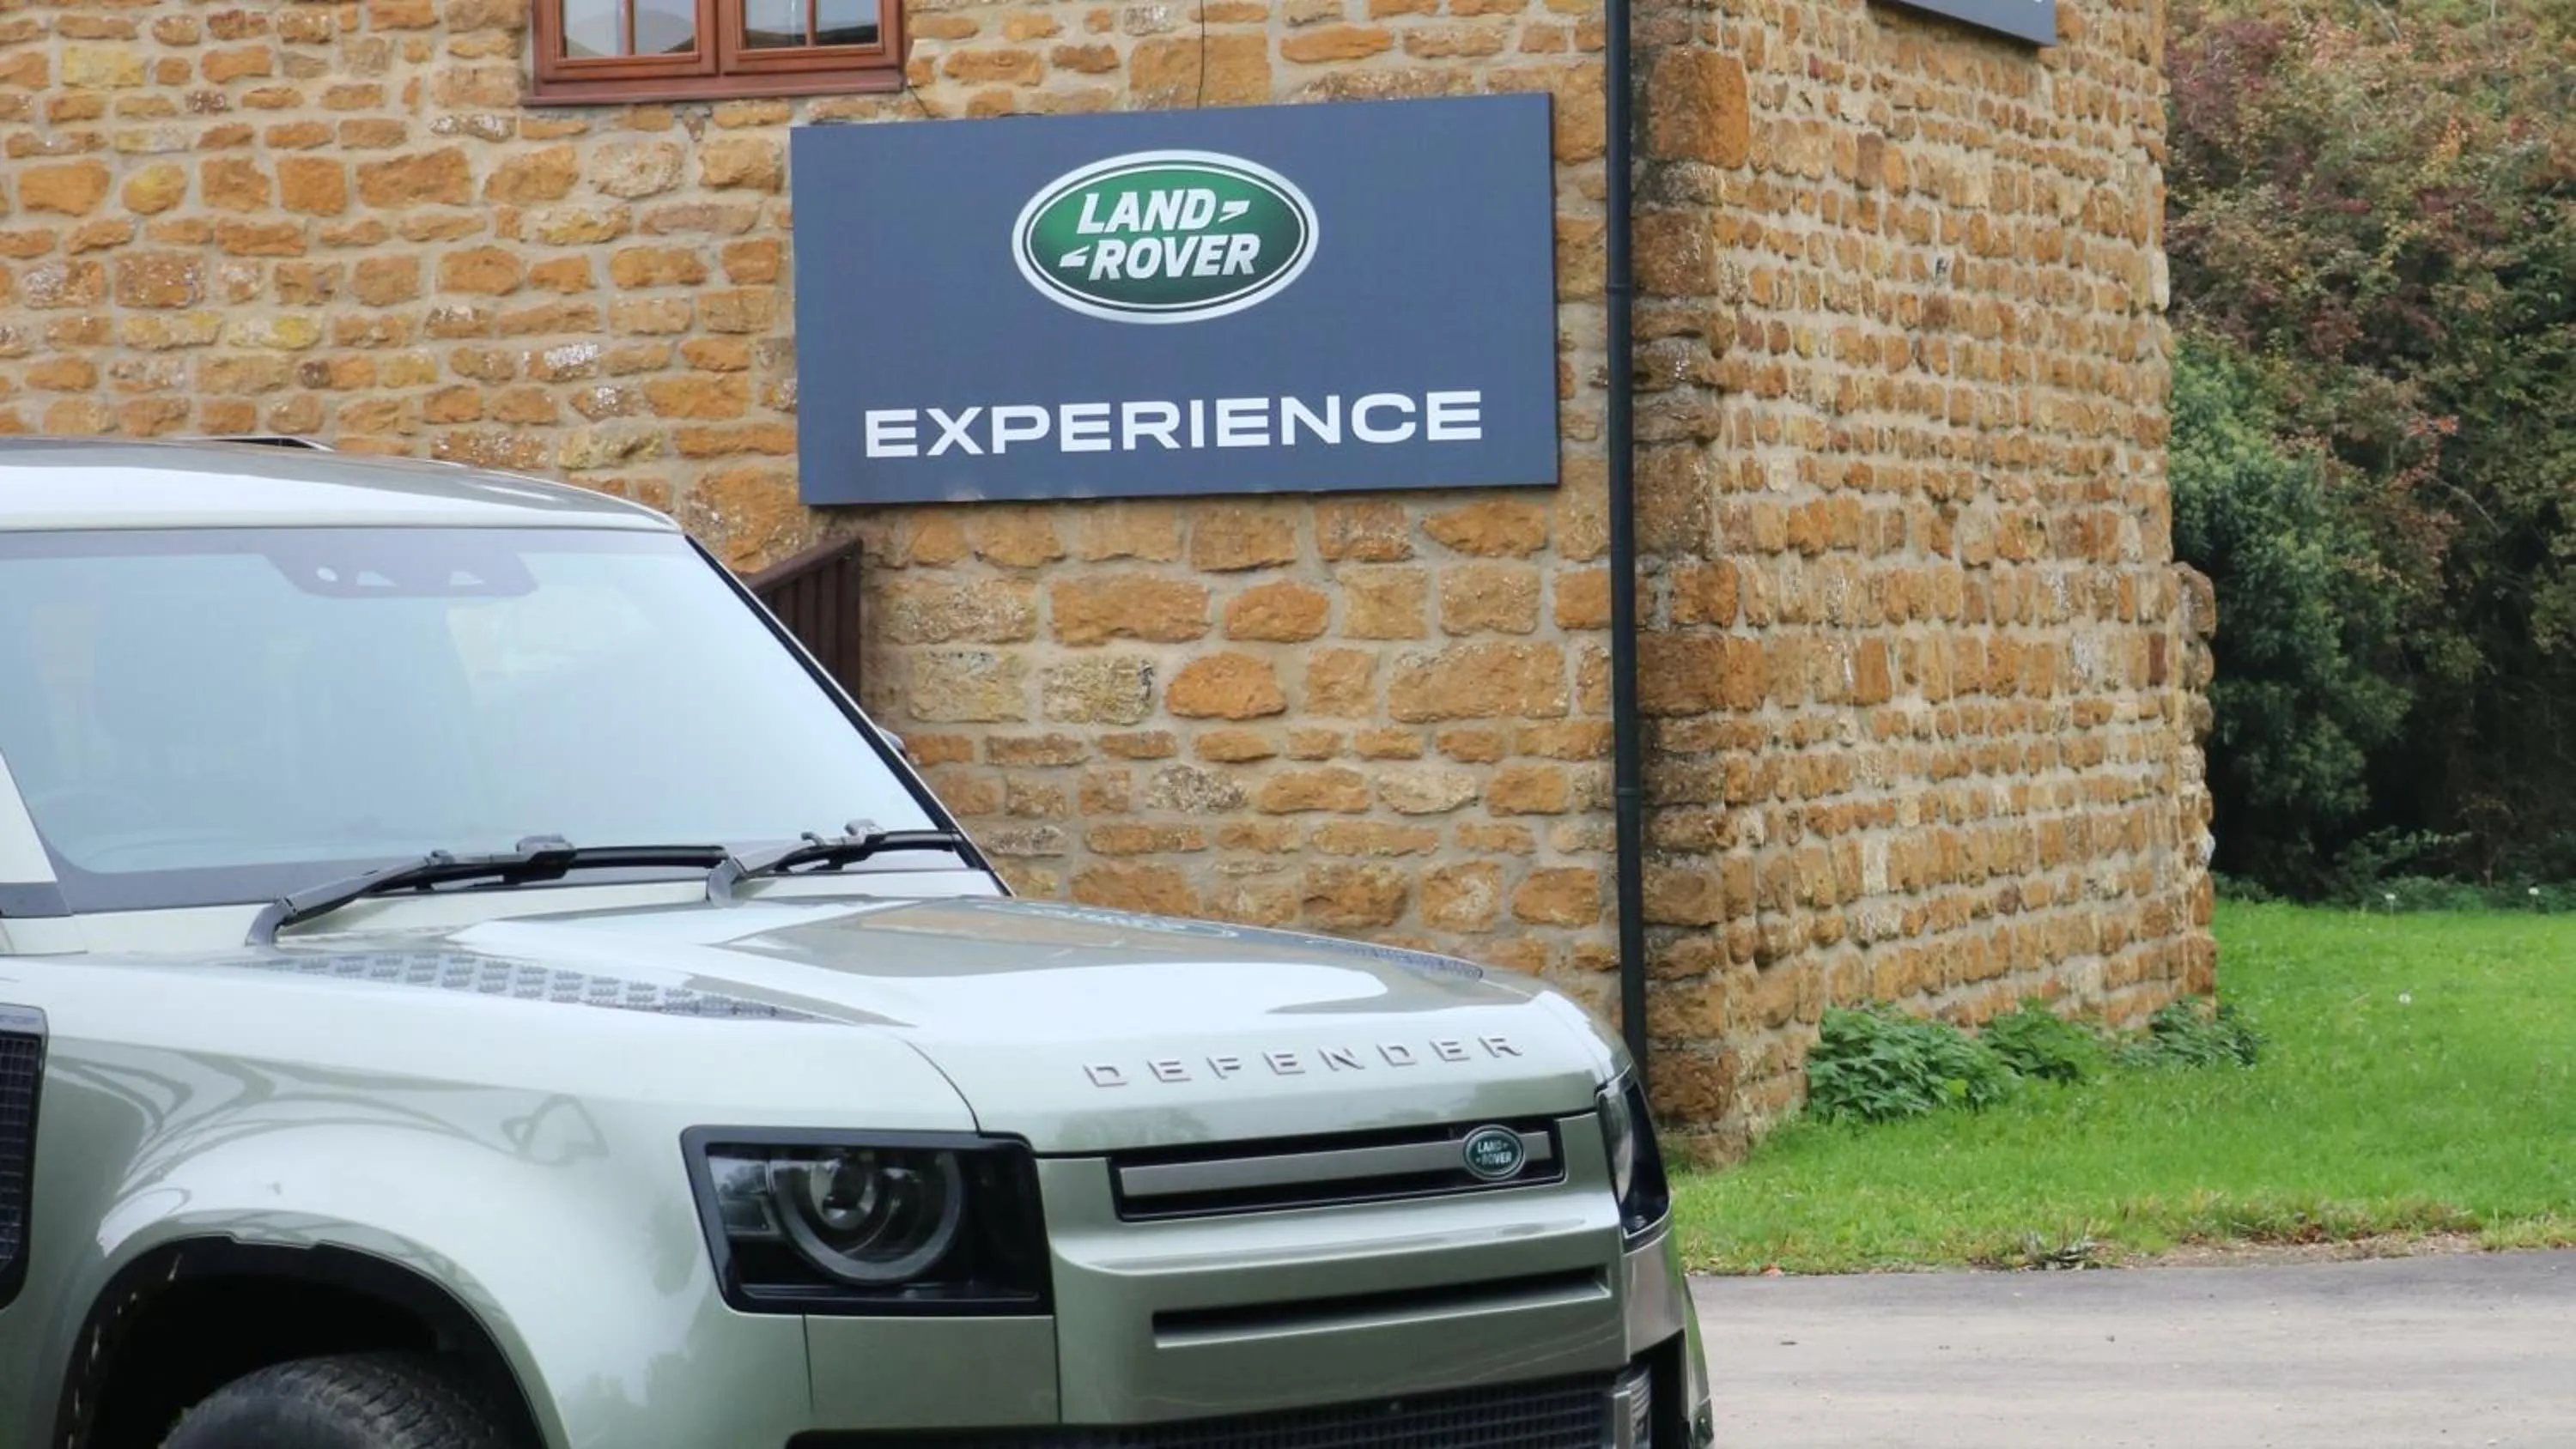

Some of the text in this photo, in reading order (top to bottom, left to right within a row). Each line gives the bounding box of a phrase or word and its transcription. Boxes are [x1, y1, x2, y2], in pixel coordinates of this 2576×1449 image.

[1076, 188, 1217, 234] LAND
[1088, 233, 1261, 281] ROVER
[865, 390, 1483, 458] EXPERIENCE
[1083, 1035, 1523, 1087] DEFENDER
